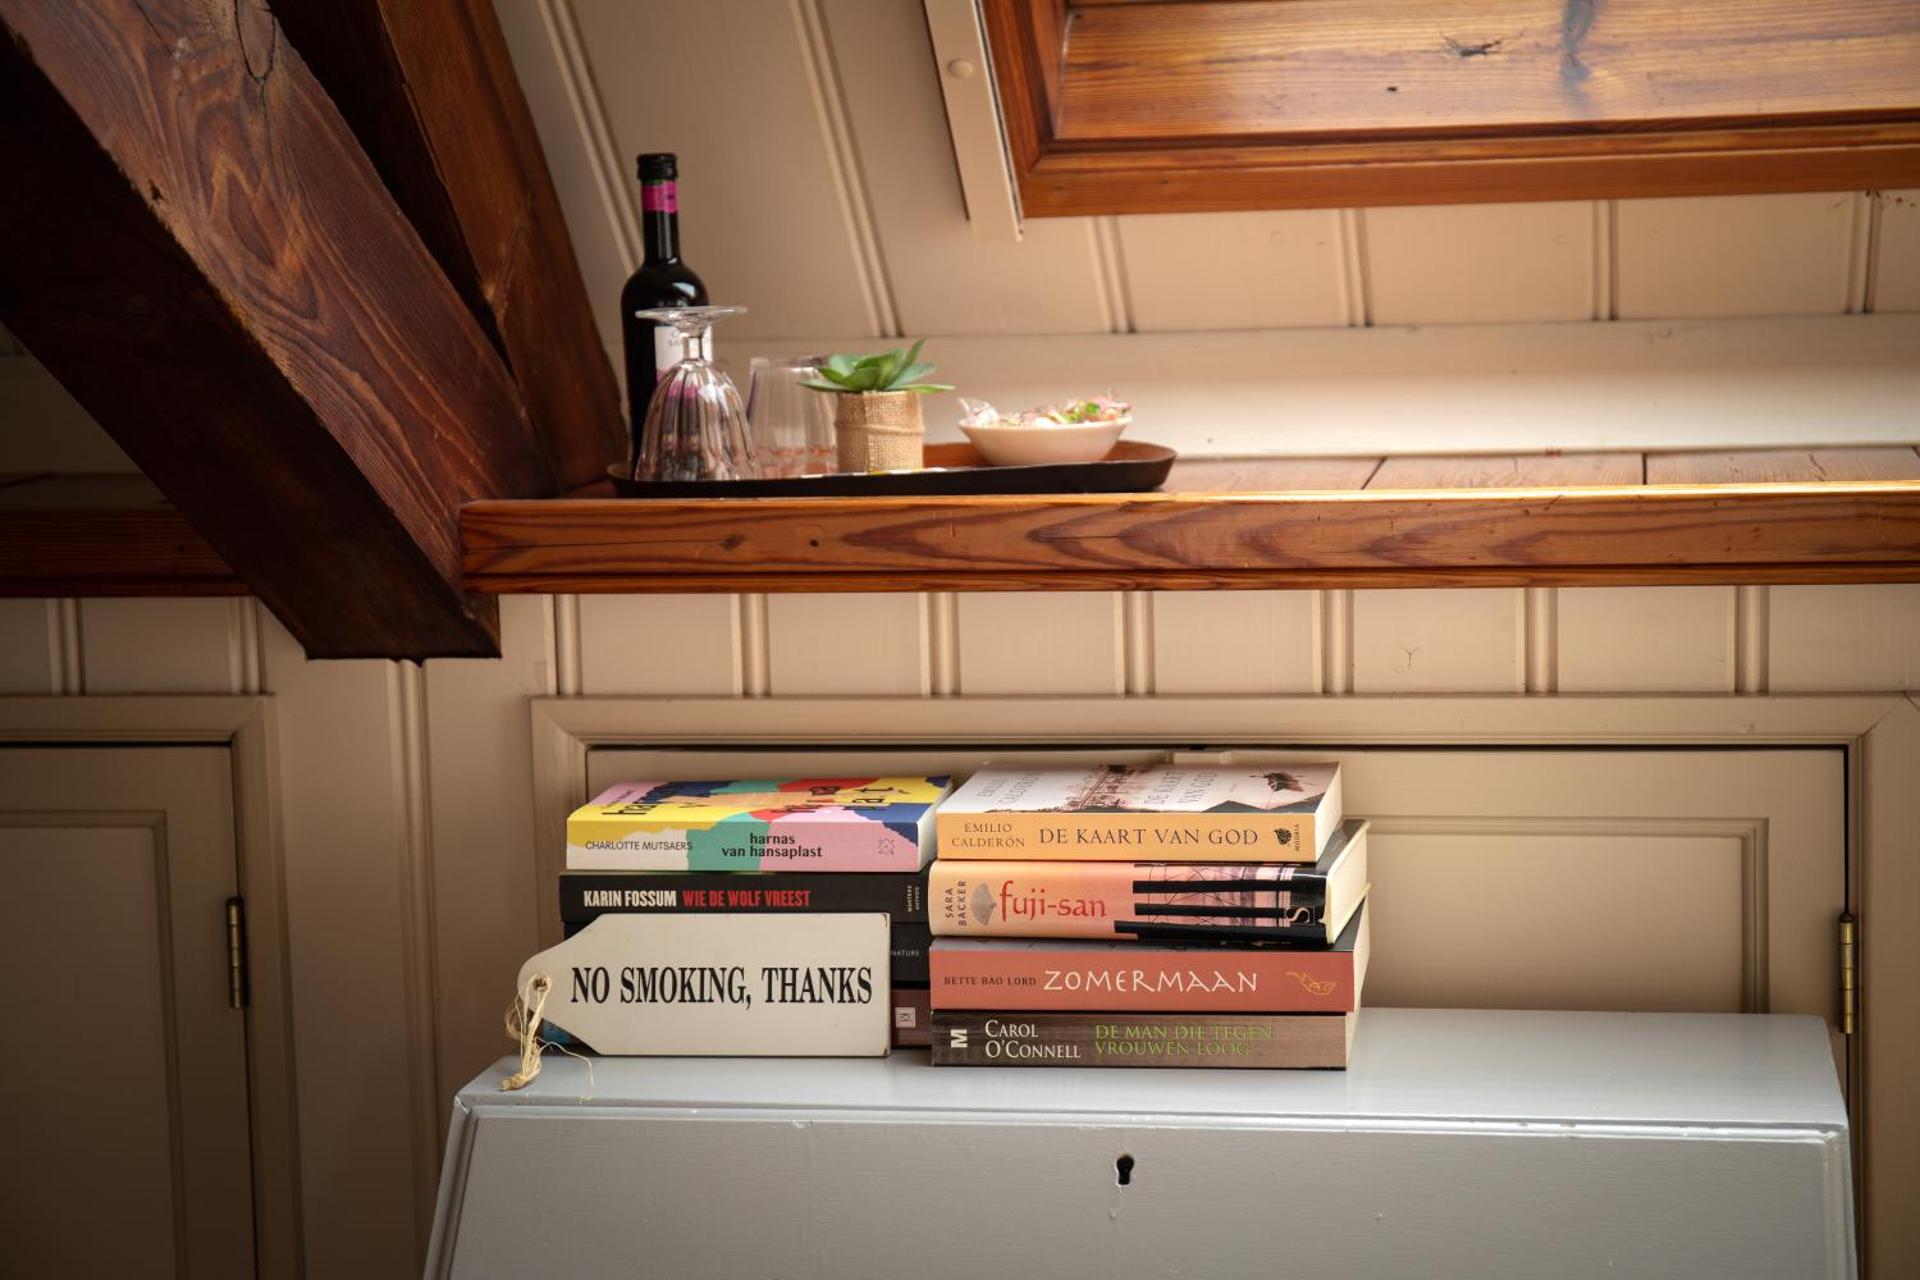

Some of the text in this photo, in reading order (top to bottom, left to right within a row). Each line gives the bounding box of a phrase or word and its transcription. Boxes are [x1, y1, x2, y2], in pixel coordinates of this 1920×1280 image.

[964, 822, 1012, 833] EMILIO
[585, 840, 694, 851] CHARLOTTE MUTSAERS
[749, 833, 796, 845] harnas
[951, 836, 1025, 848] CALDERÓN
[1039, 828, 1259, 846] DE KAART VAN GOD
[721, 846, 824, 860] van hansaplast
[583, 890, 811, 907] KARIN FOSSUM WIE DE WOLF VREEST
[945, 888, 954, 919] SARA
[957, 880, 967, 926] BACKER
[999, 880, 1108, 922] fuji-san
[570, 966, 873, 1010] NO SMOKING, THANKS
[944, 976, 1037, 986] BETTE BAO LORD
[1043, 969, 1259, 993] ZOMERMAAN
[984, 1019, 1039, 1039] CAROL
[1095, 1024, 1275, 1042] DE MAN DIE TEGEN
[985, 1040, 1081, 1059] O'CONNELL
[1095, 1041, 1250, 1057] VROUWEN LOOG
